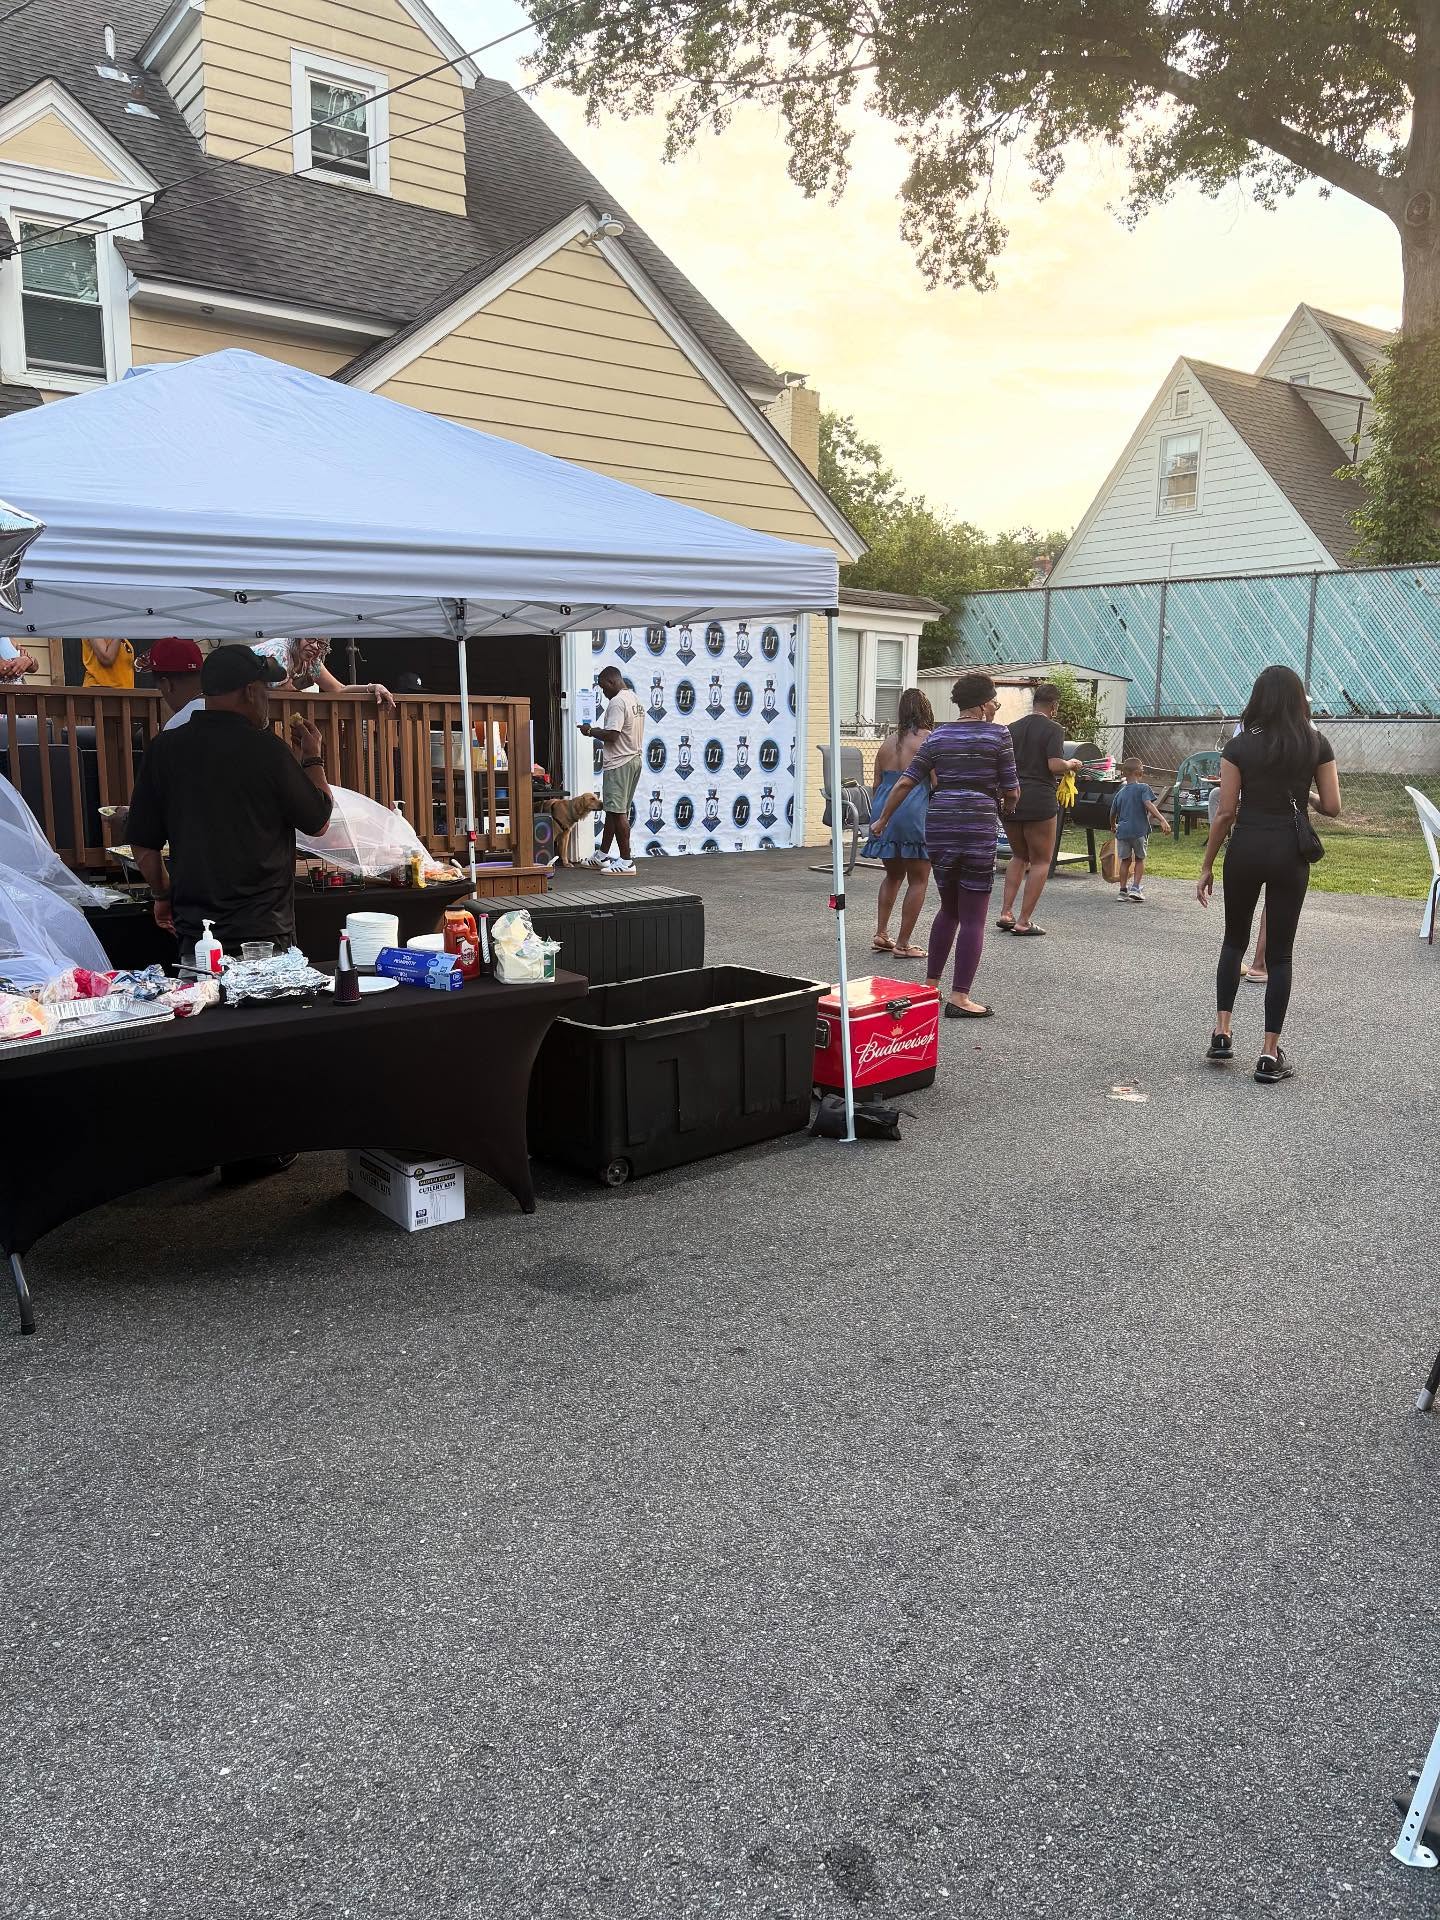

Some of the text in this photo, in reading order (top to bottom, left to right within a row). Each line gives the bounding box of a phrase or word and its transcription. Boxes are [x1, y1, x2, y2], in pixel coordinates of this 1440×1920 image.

[650, 630, 664, 644] LT
[708, 631, 722, 646] LT
[764, 636, 778, 650] LT
[679, 690, 693, 704] LT
[737, 691, 750, 706] LT
[650, 748, 664, 763] LT
[707, 748, 721, 763] LT
[762, 748, 777, 762] LT
[677, 805, 692, 819] LT
[735, 805, 748, 819] LT
[855, 1032, 935, 1065] Budweiser
[418, 1183, 443, 1194] CUTLERY
